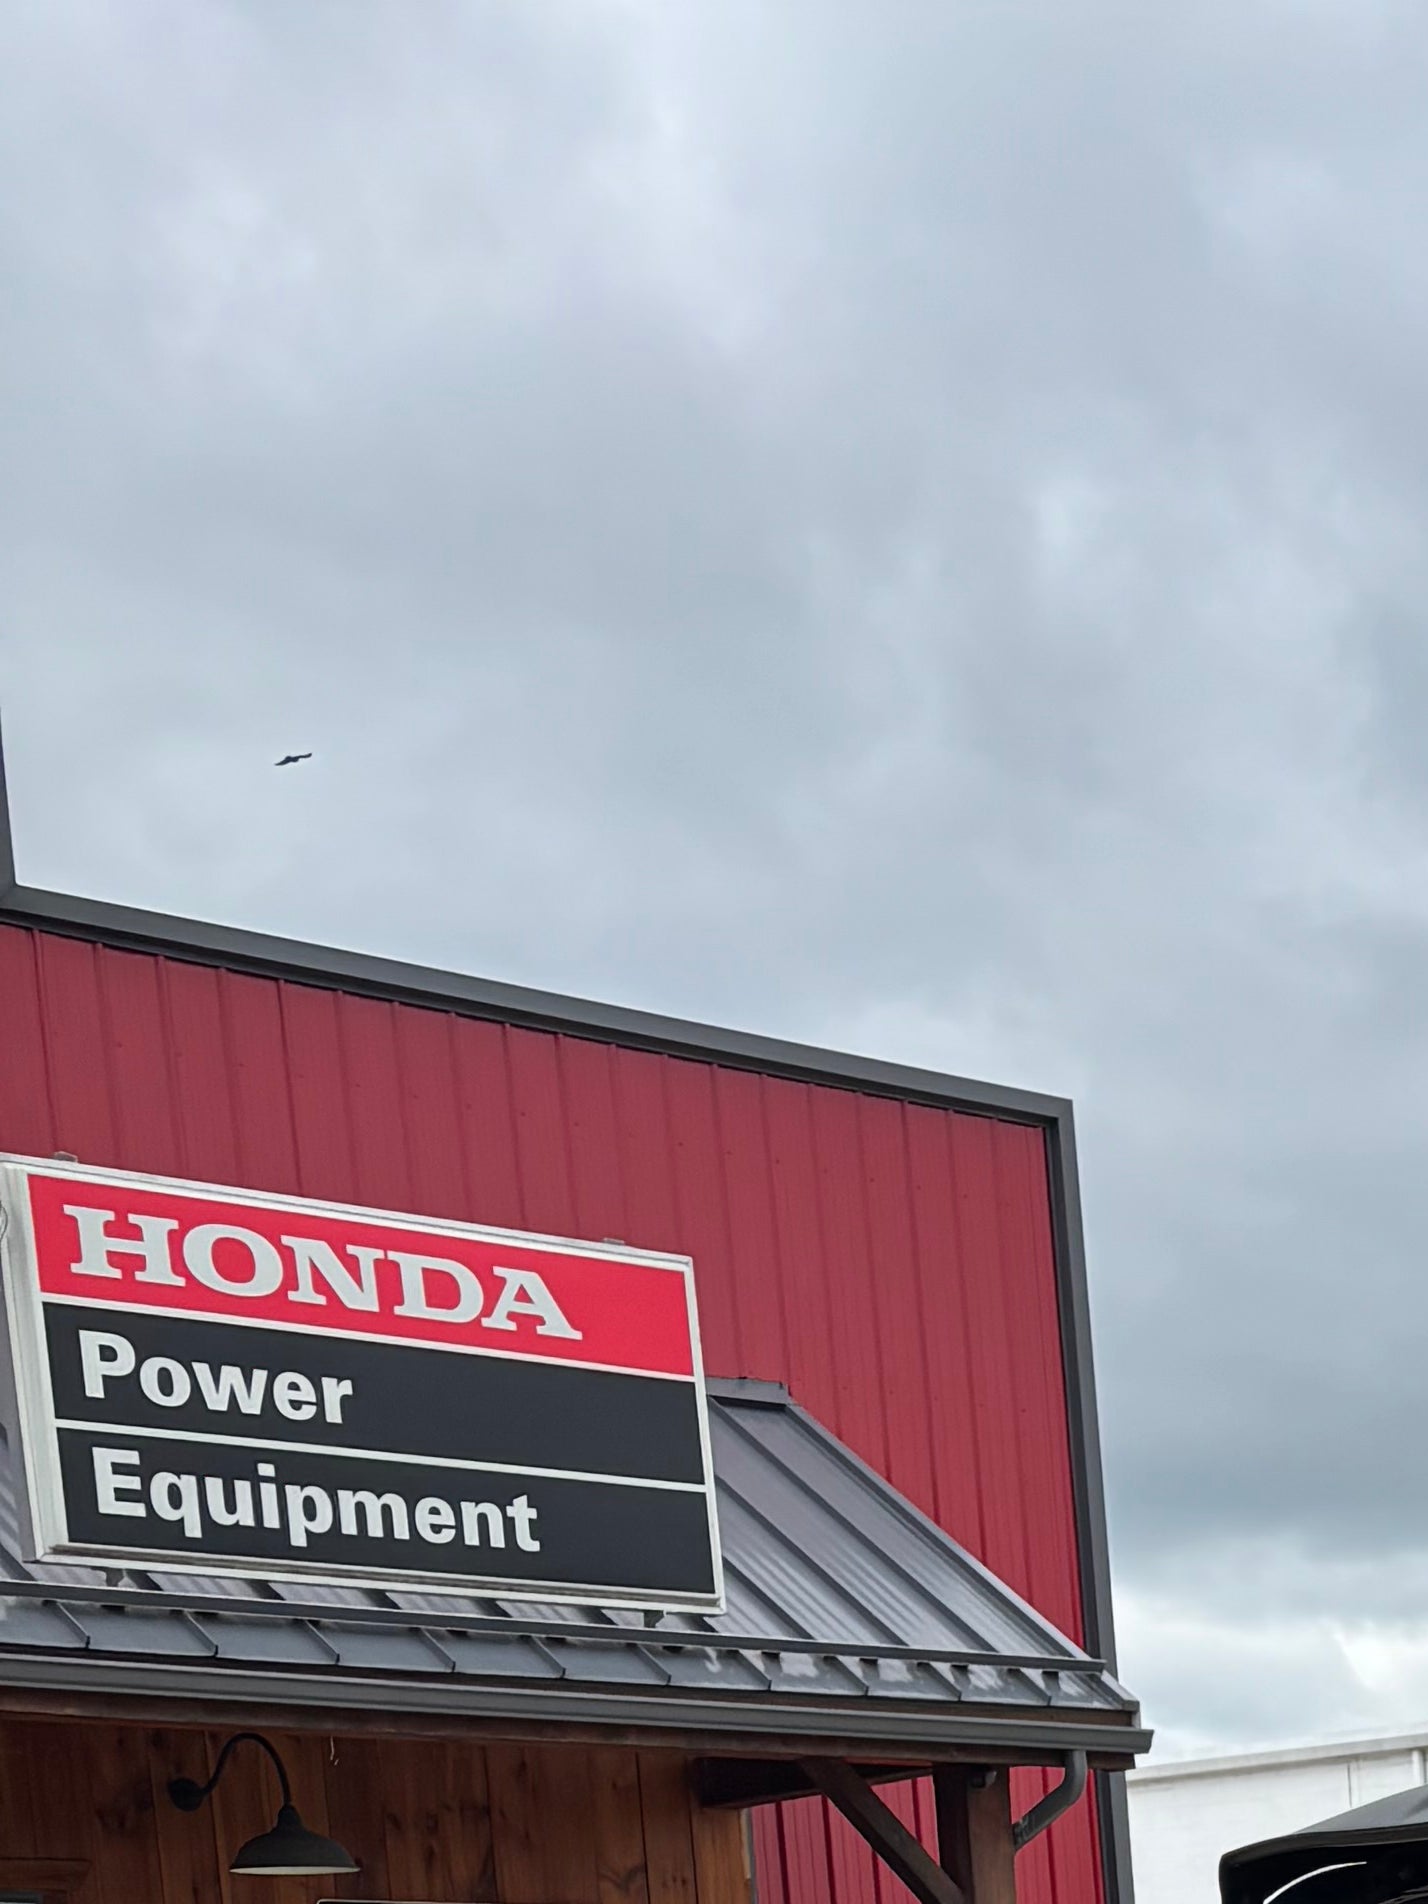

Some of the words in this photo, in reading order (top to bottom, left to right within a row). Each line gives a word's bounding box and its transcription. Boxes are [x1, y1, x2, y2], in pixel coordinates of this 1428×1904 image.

[63, 1204, 582, 1341] HONDA
[78, 1328, 354, 1425] Power
[92, 1447, 541, 1553] Equipment
